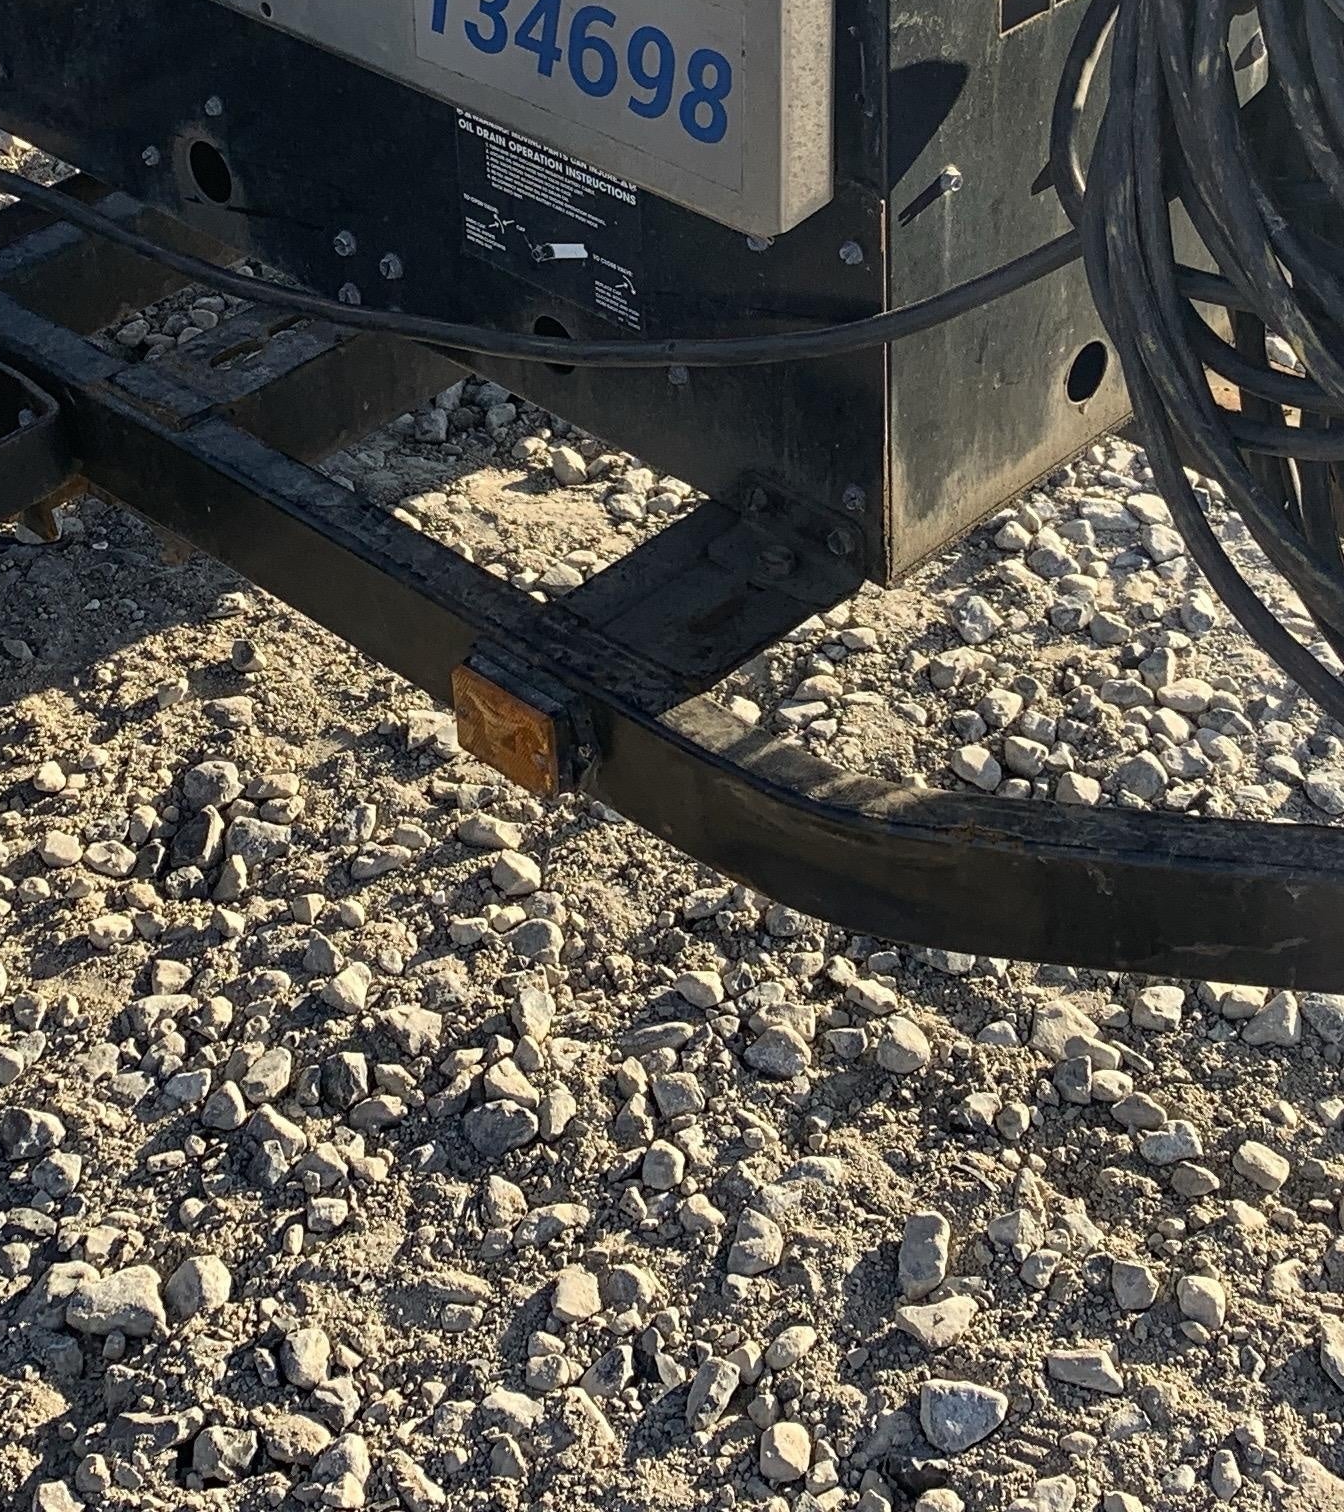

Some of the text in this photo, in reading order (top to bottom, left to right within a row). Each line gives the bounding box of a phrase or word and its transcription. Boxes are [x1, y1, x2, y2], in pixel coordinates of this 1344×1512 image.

[458, 118, 474, 133] OIL
[476, 126, 506, 147] DRAIN
[508, 140, 564, 173] OPERATION
[565, 165, 637, 206] INSTRUCTIONS
